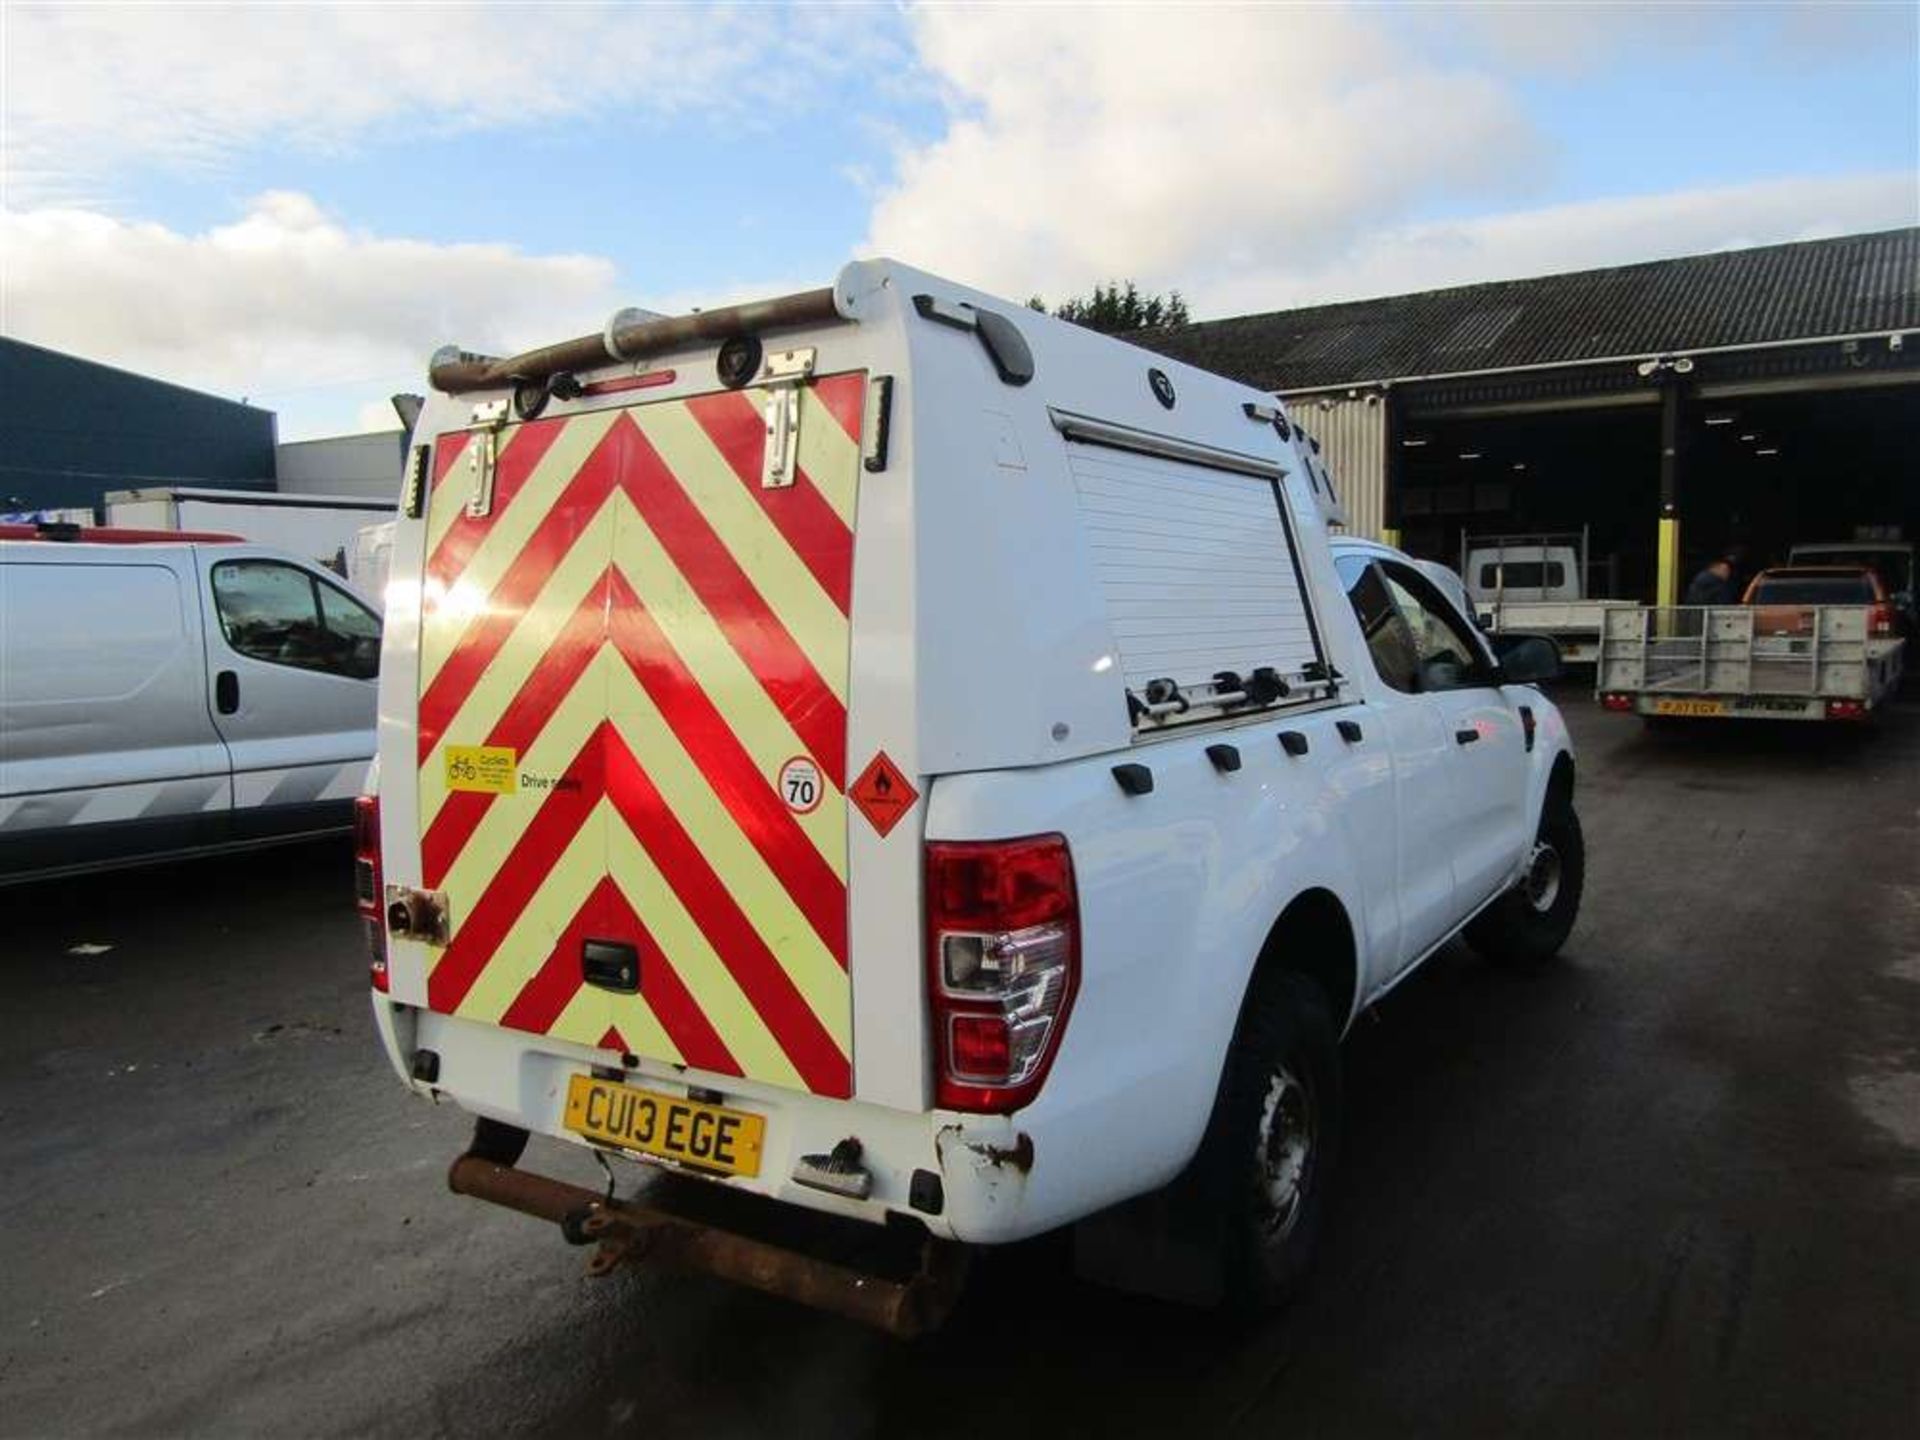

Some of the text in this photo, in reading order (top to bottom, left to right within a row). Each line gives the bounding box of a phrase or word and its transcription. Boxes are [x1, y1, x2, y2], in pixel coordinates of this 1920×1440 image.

[521, 773, 548, 789] Drive
[788, 780, 814, 804] 70
[586, 1086, 740, 1164] CU13 EGE
